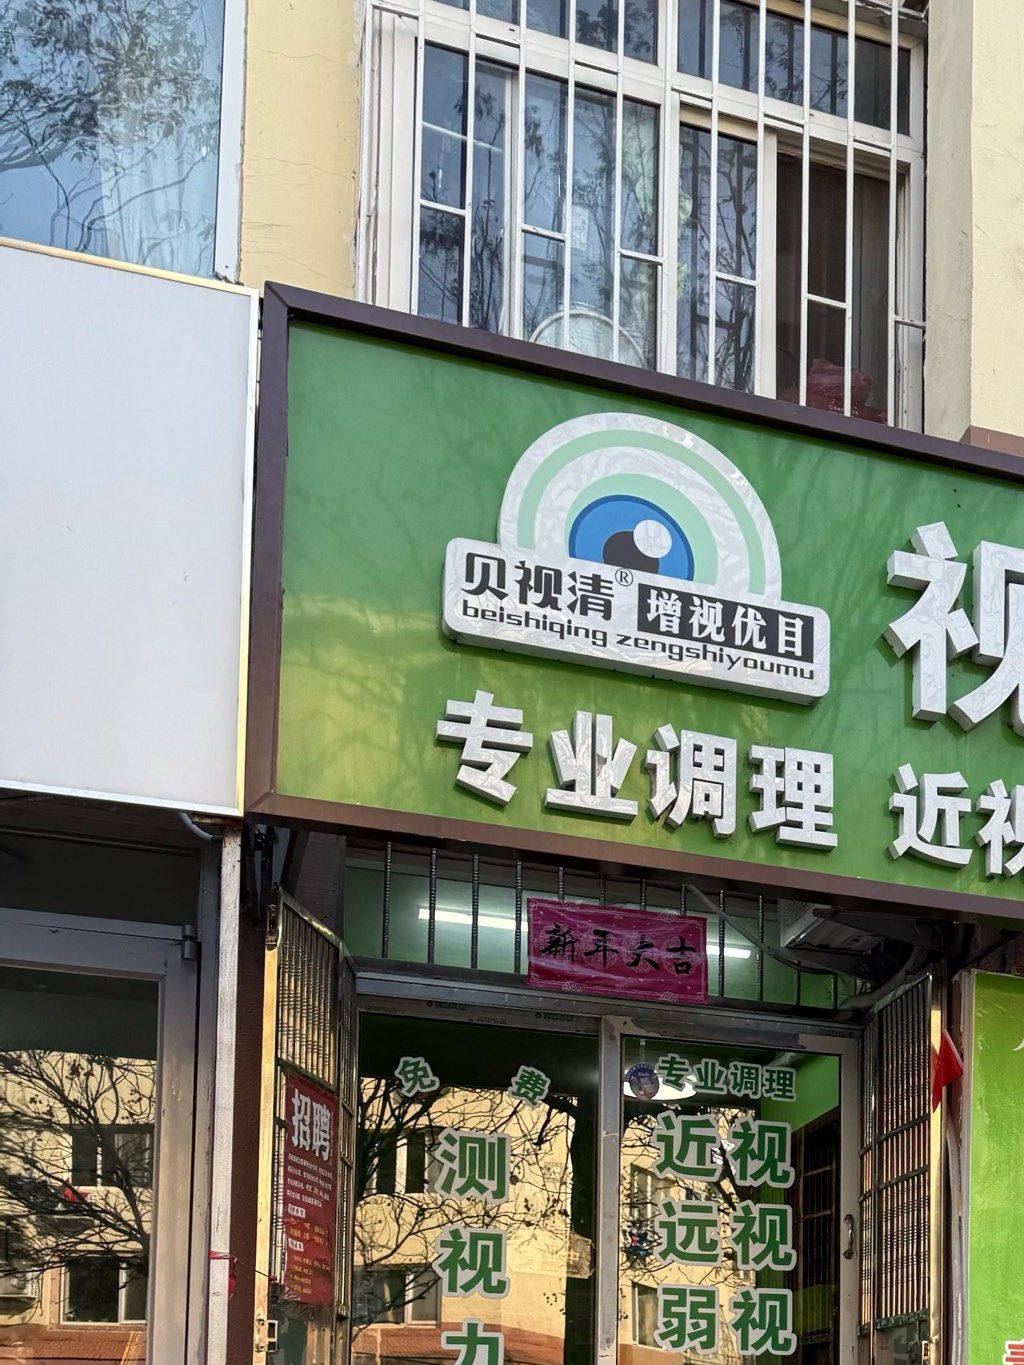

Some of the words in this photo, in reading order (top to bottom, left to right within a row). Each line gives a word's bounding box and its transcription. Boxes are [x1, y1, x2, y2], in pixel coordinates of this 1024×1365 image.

[462, 600, 607, 648] beishiqing
[617, 634, 814, 680] zengshiyoumu
[646, 588, 804, 658] 增视优目
[436, 690, 838, 851] 专业调理
[656, 1053, 796, 1101] 专业调理
[292, 1087, 331, 1161] 招聘
[653, 1110, 794, 1188] 近视
[654, 1202, 794, 1272] 远视
[656, 1285, 797, 1355] 弱视
